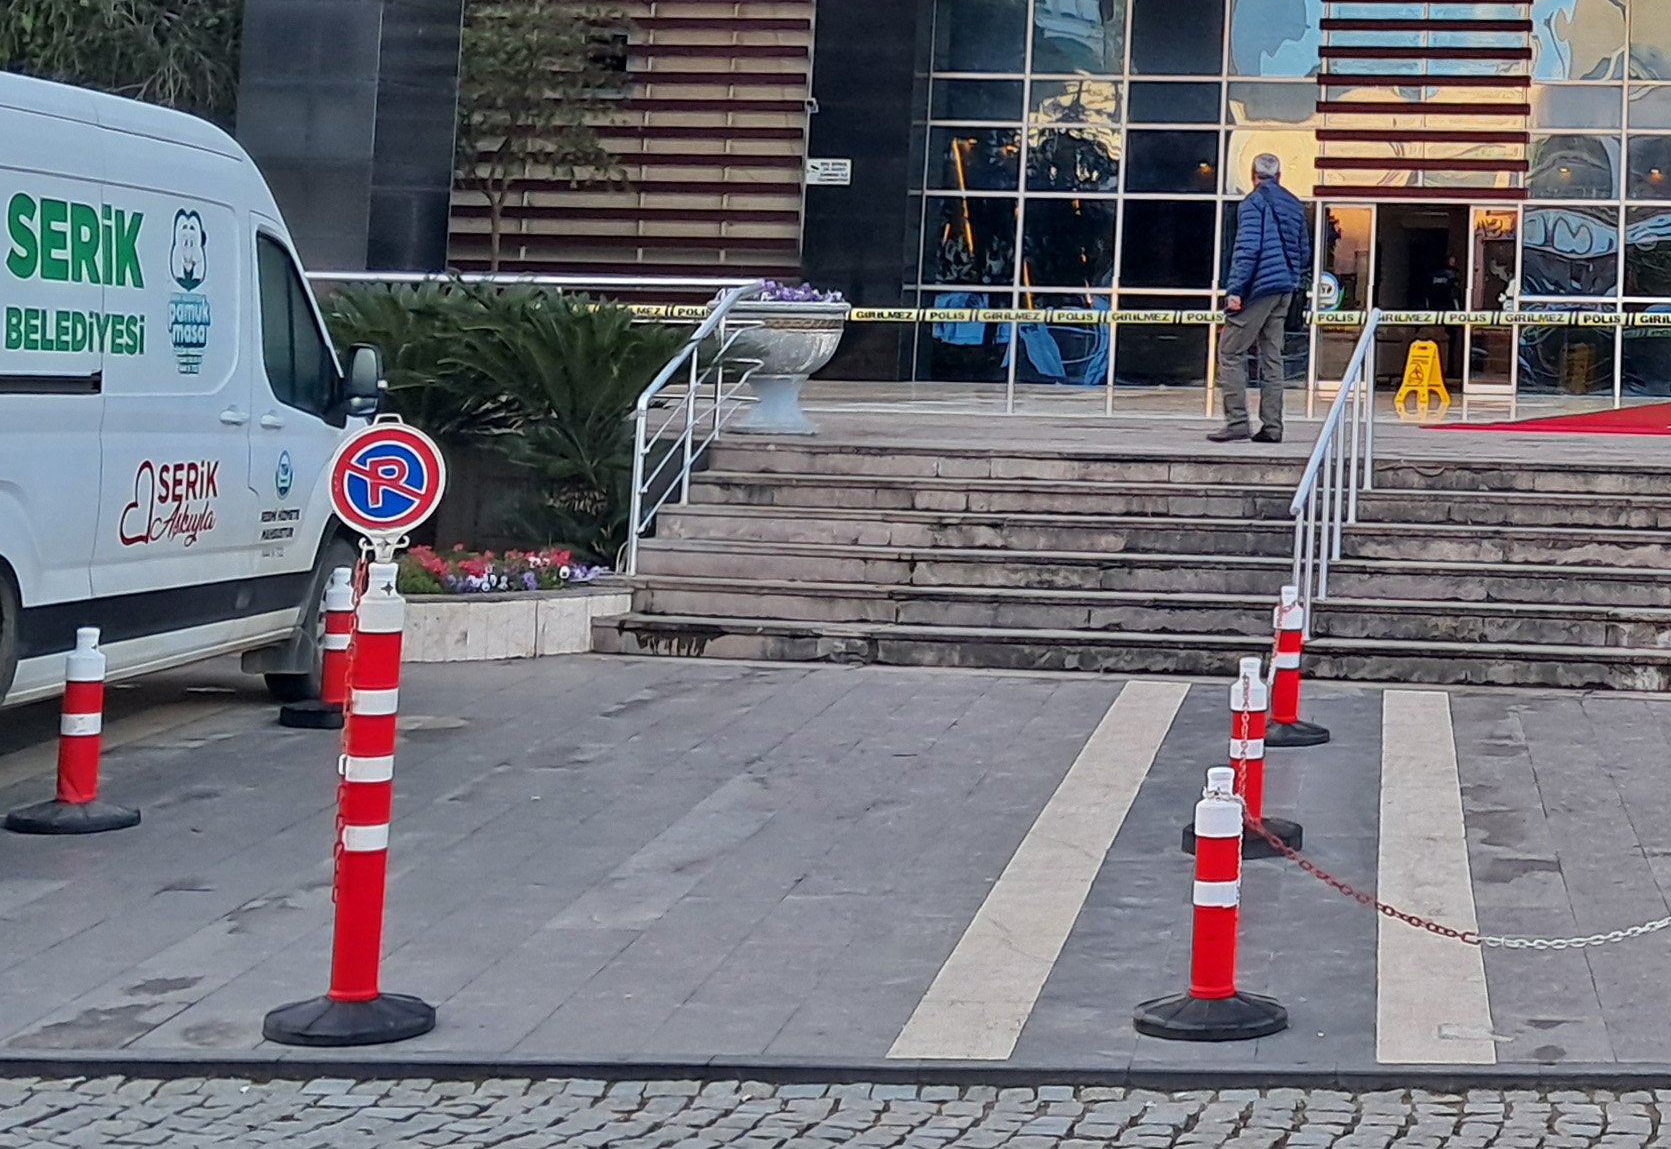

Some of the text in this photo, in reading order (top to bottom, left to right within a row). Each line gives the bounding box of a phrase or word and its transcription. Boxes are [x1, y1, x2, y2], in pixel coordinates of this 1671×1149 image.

[6, 192, 145, 289] SERİK
[5, 306, 145, 355] BELEDİYESİ
[168, 295, 210, 333] pamuk
[173, 324, 206, 345] masa
[158, 460, 219, 504] SERİK
